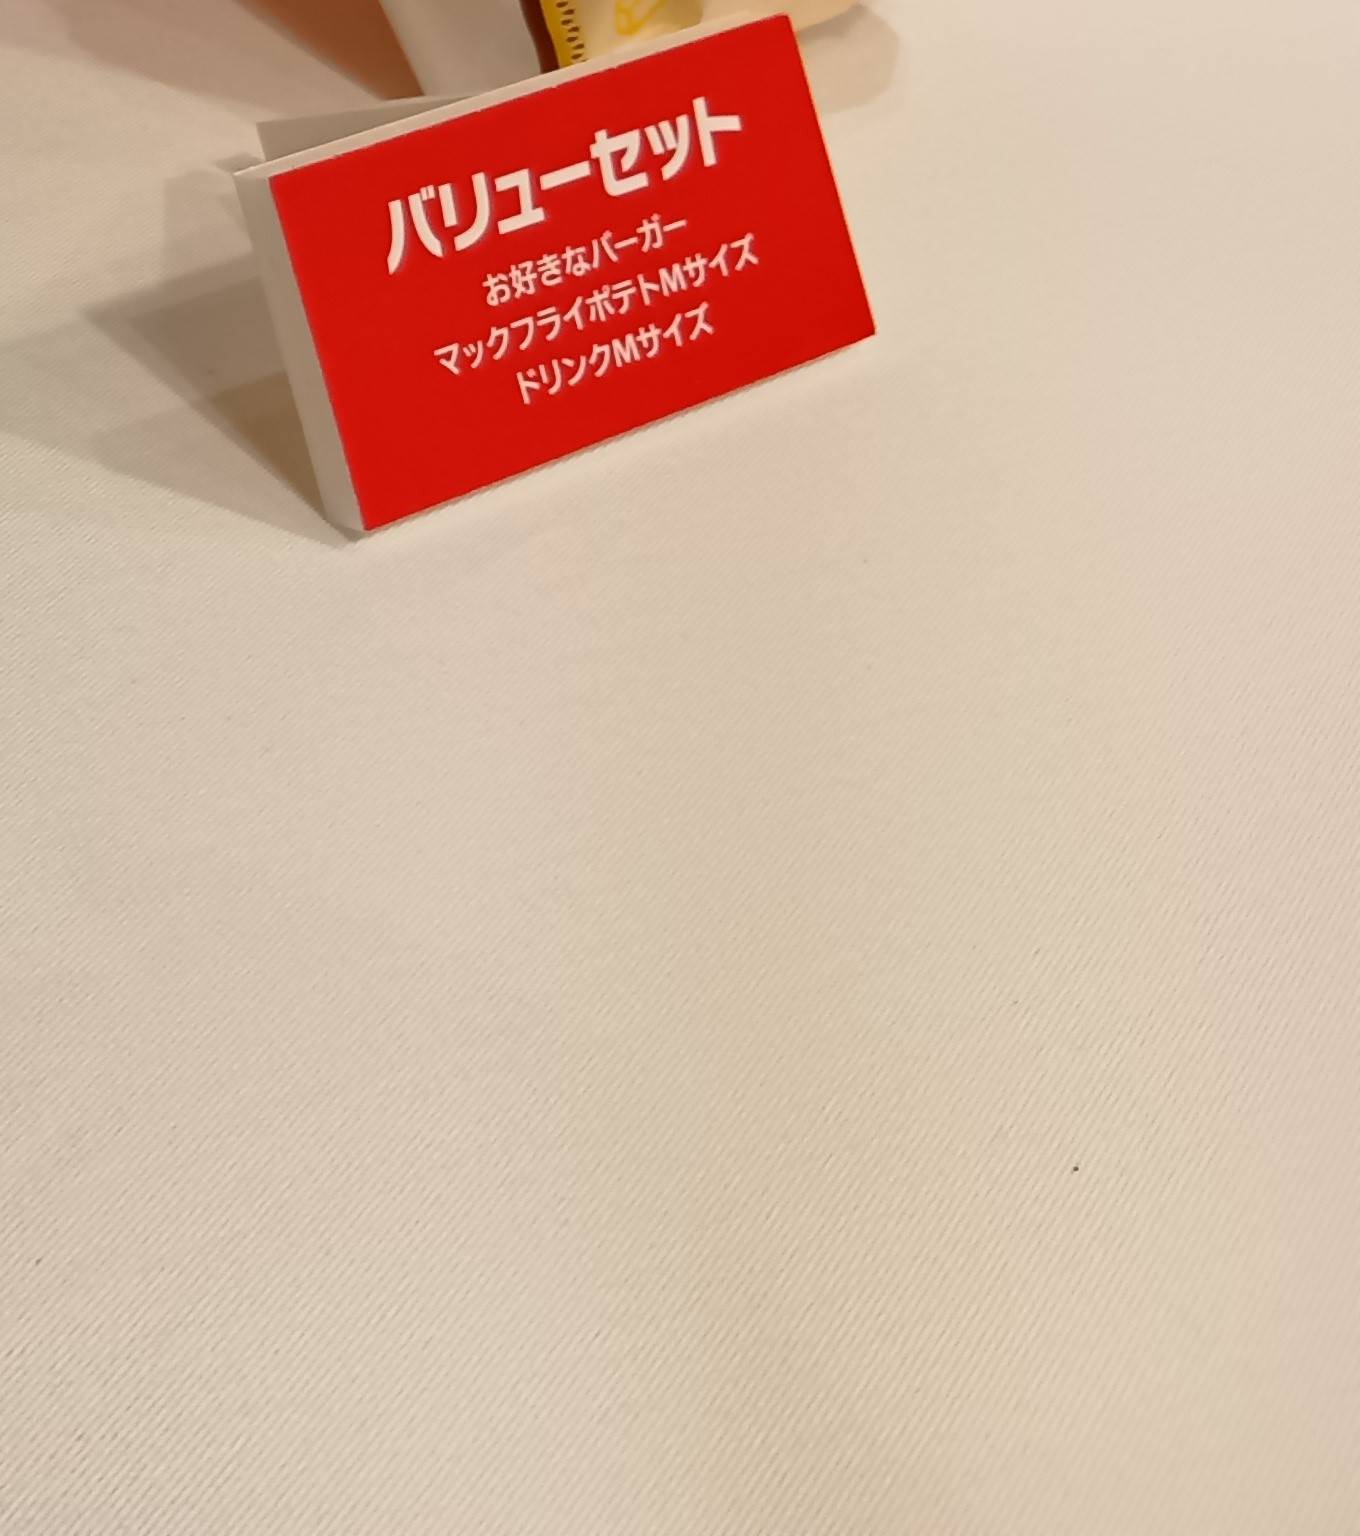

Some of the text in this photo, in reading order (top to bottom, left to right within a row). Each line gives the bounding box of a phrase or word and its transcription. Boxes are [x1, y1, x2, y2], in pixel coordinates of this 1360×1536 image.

[387, 96, 742, 275] バリューセット
[433, 232, 759, 377] マックフライポテトMサイズ
[482, 213, 687, 308] お好きなバーガー
[517, 302, 714, 405] ドリンクMサイズ
